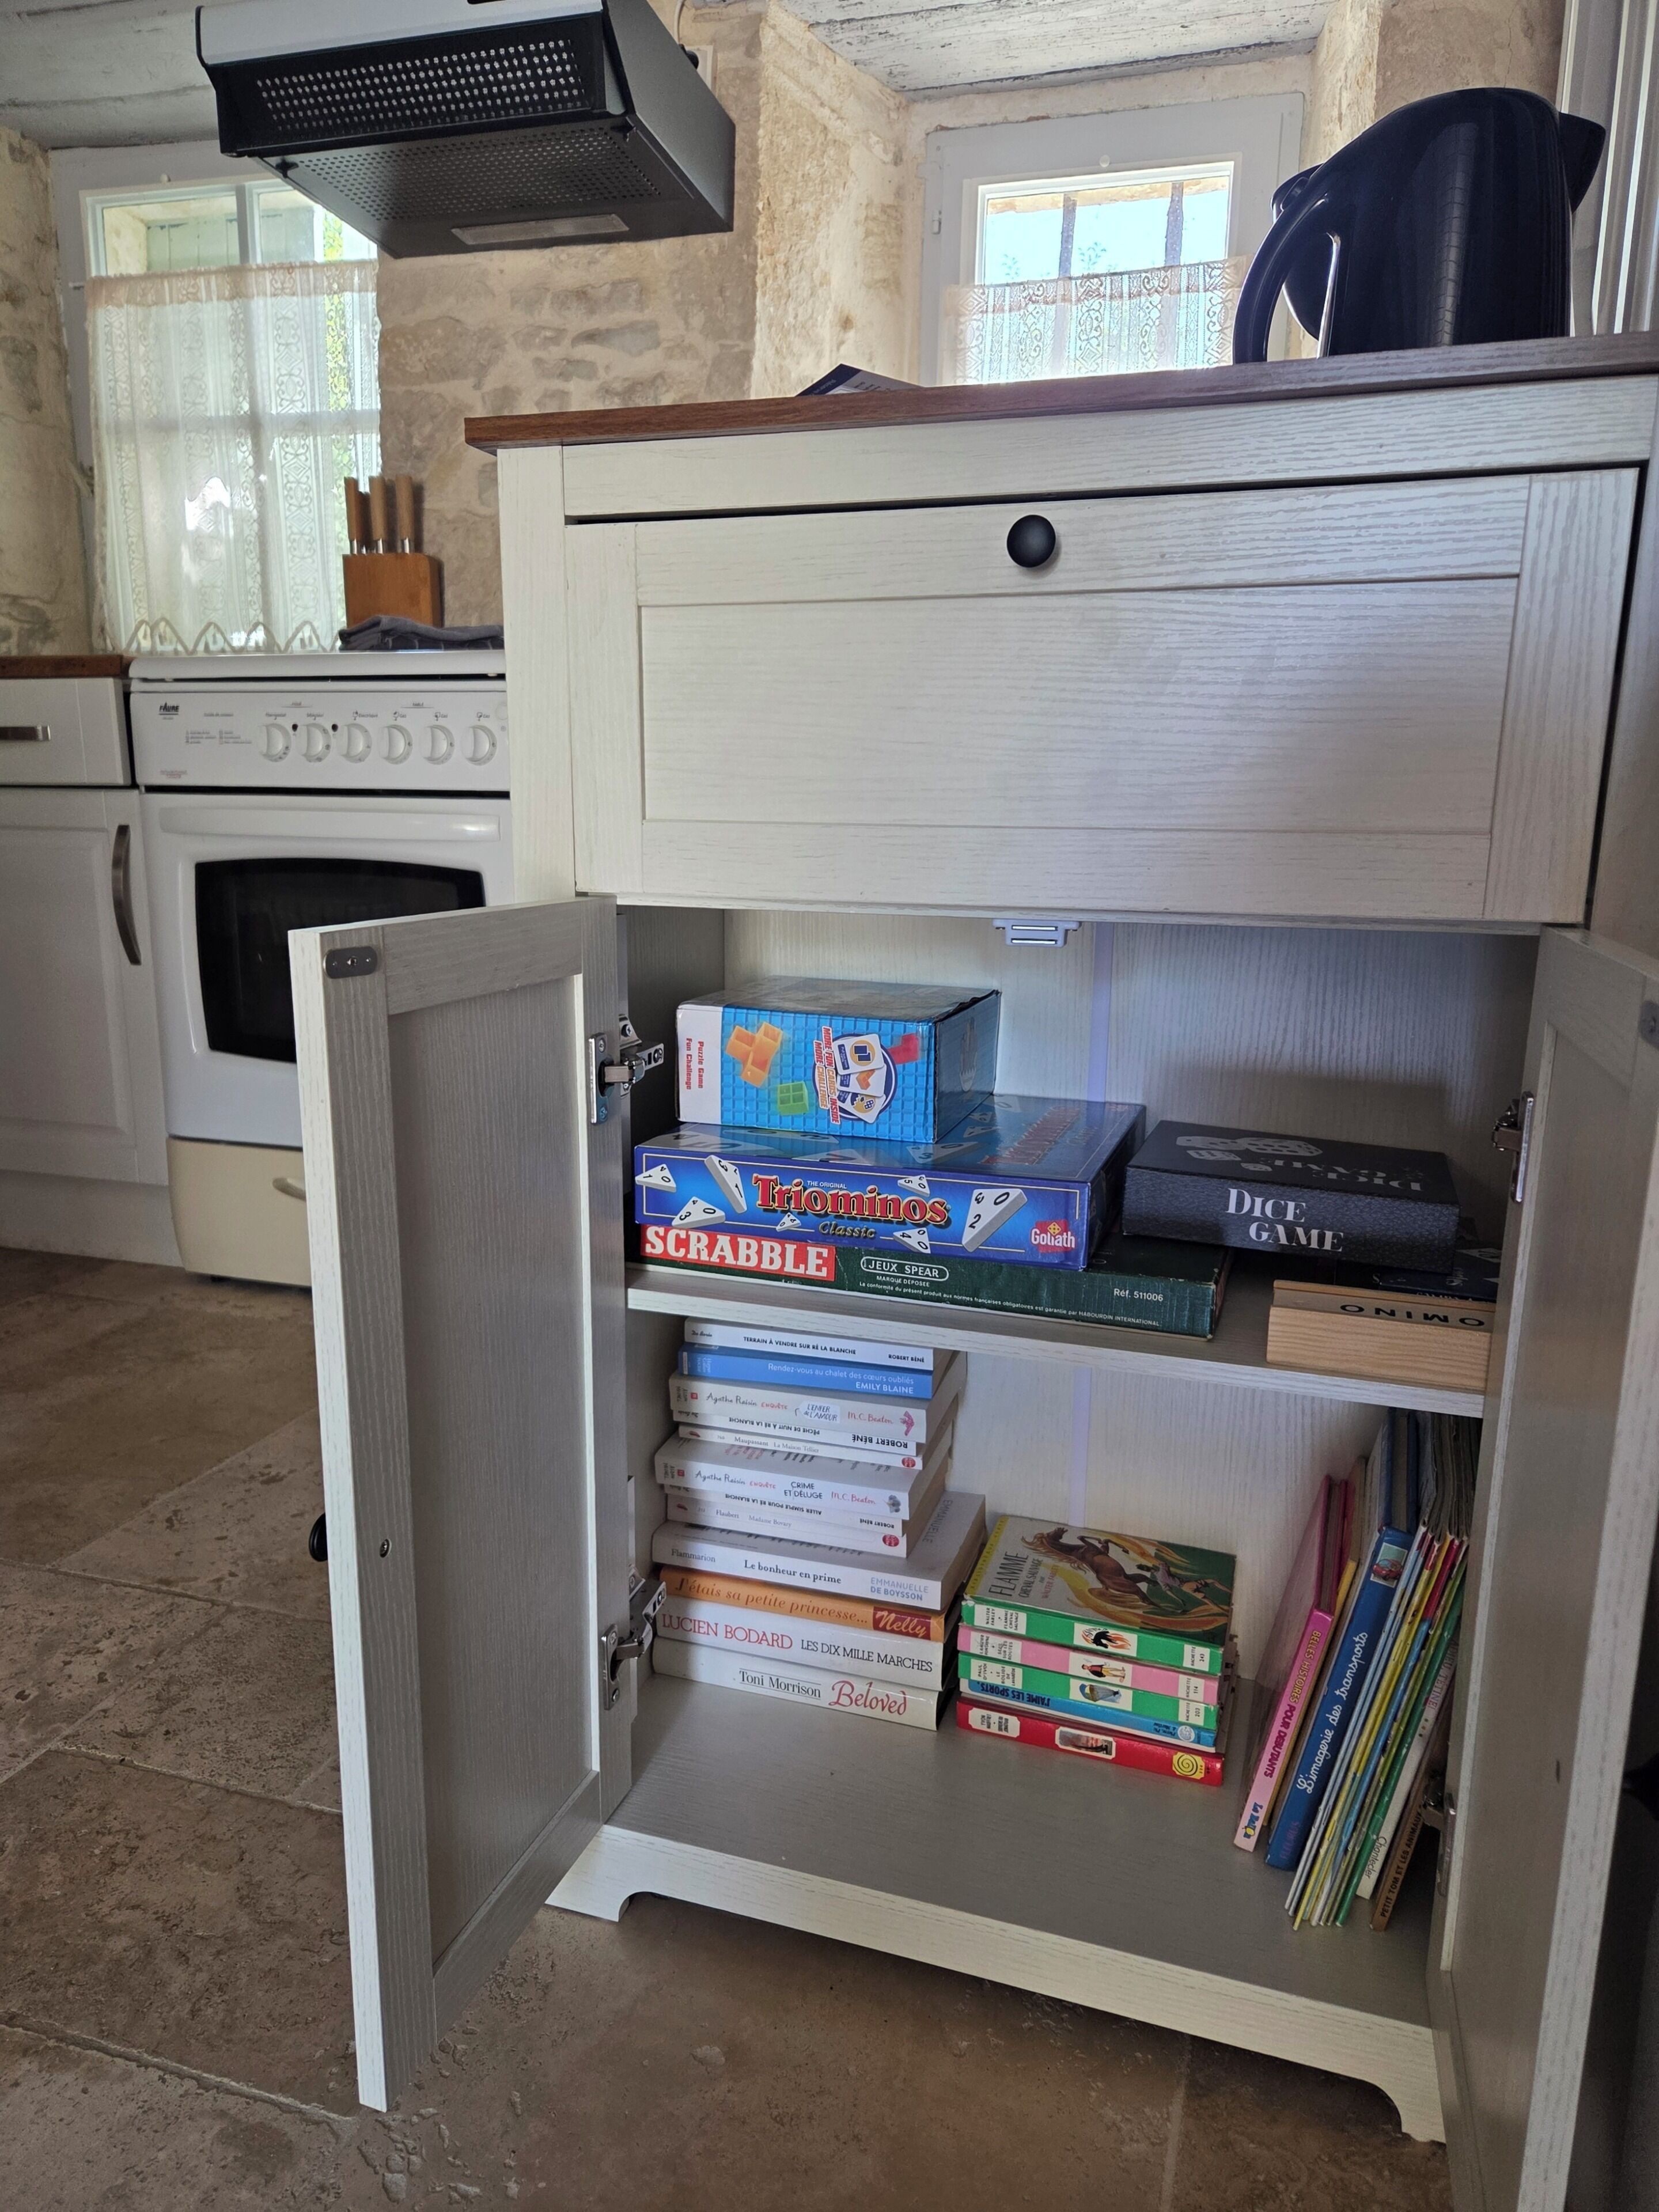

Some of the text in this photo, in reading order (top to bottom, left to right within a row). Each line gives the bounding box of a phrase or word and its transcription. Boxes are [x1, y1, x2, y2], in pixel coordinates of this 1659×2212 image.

[159, 701, 179, 713] FAURE
[815, 1041, 829, 1108] MORE CHALLENGE
[823, 1027, 840, 1123] MORE FUN CARDS INSIDE
[819, 1181, 847, 1190] ORIGINAL
[752, 1173, 949, 1225] Triominos
[974, 1192, 984, 1204] 3
[993, 1191, 1010, 1206] 0
[1225, 1188, 1306, 1222] DICE
[679, 1211, 691, 1221] 3
[968, 1213, 982, 1229] 2
[819, 1221, 877, 1239] Classic
[1031, 1228, 1075, 1249] Goliath
[1249, 1221, 1344, 1252] GAME
[645, 1226, 828, 1278] SCRABBLE
[918, 1241, 928, 1250] 0
[869, 1260, 898, 1272] JEUX
[904, 1265, 939, 1278] SPEAR
[876, 1276, 930, 1287] MARQUE DEPOSEE
[867, 1282, 893, 1290] conformité
[974, 1297, 1001, 1305] françaises
[1002, 1301, 1033, 1310] obligatoires
[1045, 1306, 1067, 1315] garantie
[1078, 1311, 1113, 1320] HABOURDIN
[1113, 1288, 1164, 1302] Réf. 511006
[743, 1336, 768, 1344] TERRAIN
[830, 1347, 856, 1355] BLANCHE
[768, 1363, 813, 1374] Rendez-vous
[825, 1370, 847, 1378] chalet
[888, 1376, 914, 1384] oubliés
[855, 1382, 914, 1394] EMILY BLAINE
[706, 1392, 788, 1410] Agathe Raisin ENQUÊTE
[807, 1403, 831, 1411] L'ENFER
[729, 1416, 755, 1425] BLANCHE
[868, 1414, 893, 1425] Beaton
[734, 1436, 769, 1447] Maupassant
[851, 1434, 908, 1449] ROBERT BÉNÉ
[695, 1470, 777, 1489] Agathe Raisin ENQUÊTE
[791, 1481, 815, 1490] CRIME
[725, 1493, 751, 1502] BLANCHE
[794, 1490, 823, 1499] DÉLUGE
[716, 1509, 740, 1519] Flaubert
[785, 1504, 805, 1512] SIMPLE
[749, 1514, 793, 1528] Madame Bovary
[922, 1499, 953, 1544] EMMANUELLE
[671, 1548, 716, 1563] Flammarion
[744, 1560, 842, 1584] Le bonheur en prime
[988, 1551, 1029, 1597] FLAMME
[870, 1577, 930, 1593] EMMANUELLE
[870, 1586, 923, 1601] DE BOYSSON
[676, 1577, 868, 1624] J'étais sa petite princesse...
[662, 1613, 793, 1649] LUCIEN BODARD
[875, 1610, 927, 1638] Nelly
[1305, 1630, 1322, 1659] BELLES
[801, 1639, 933, 1672] LES DIX MILLE MARCHES
[740, 1670, 821, 1698] Toni Morrison
[1289, 1660, 1311, 1704] HISTOIRES
[828, 1680, 908, 1715] Beloved
[1279, 1703, 1297, 1729] POUR
[1297, 1631, 1368, 1794] L'imagerie des transports
[1365, 1836, 1387, 1878] Chantecler
[1399, 1850, 1410, 1864] LES
[1395, 1862, 1404, 1876] ET
[1390, 1876, 1400, 1893] TOM
[1380, 1893, 1393, 1918] PETIT
